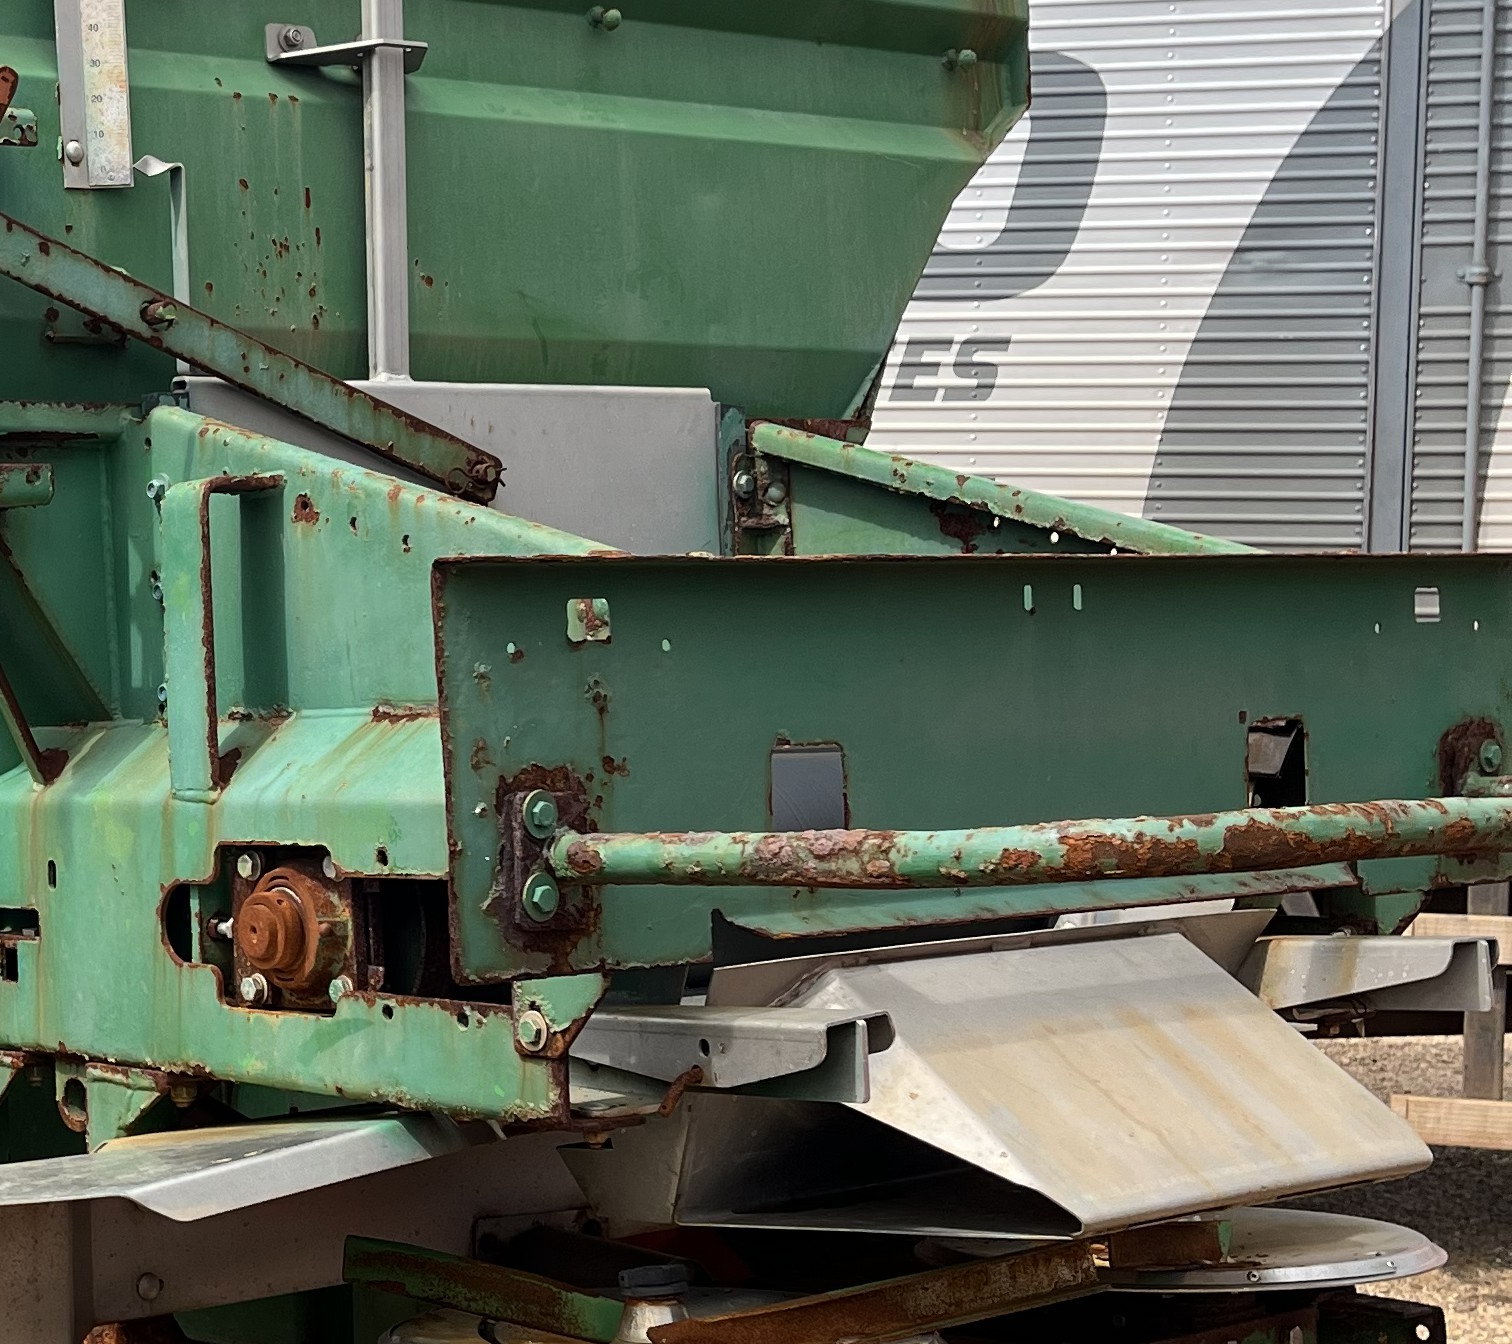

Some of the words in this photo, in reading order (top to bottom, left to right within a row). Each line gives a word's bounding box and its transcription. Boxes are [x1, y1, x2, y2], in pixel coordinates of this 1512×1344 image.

[87, 23, 99, 32] 40
[89, 59, 101, 68] 30
[91, 94, 103, 103] 20
[93, 130, 105, 138] 10
[887, 336, 1012, 402] ES
